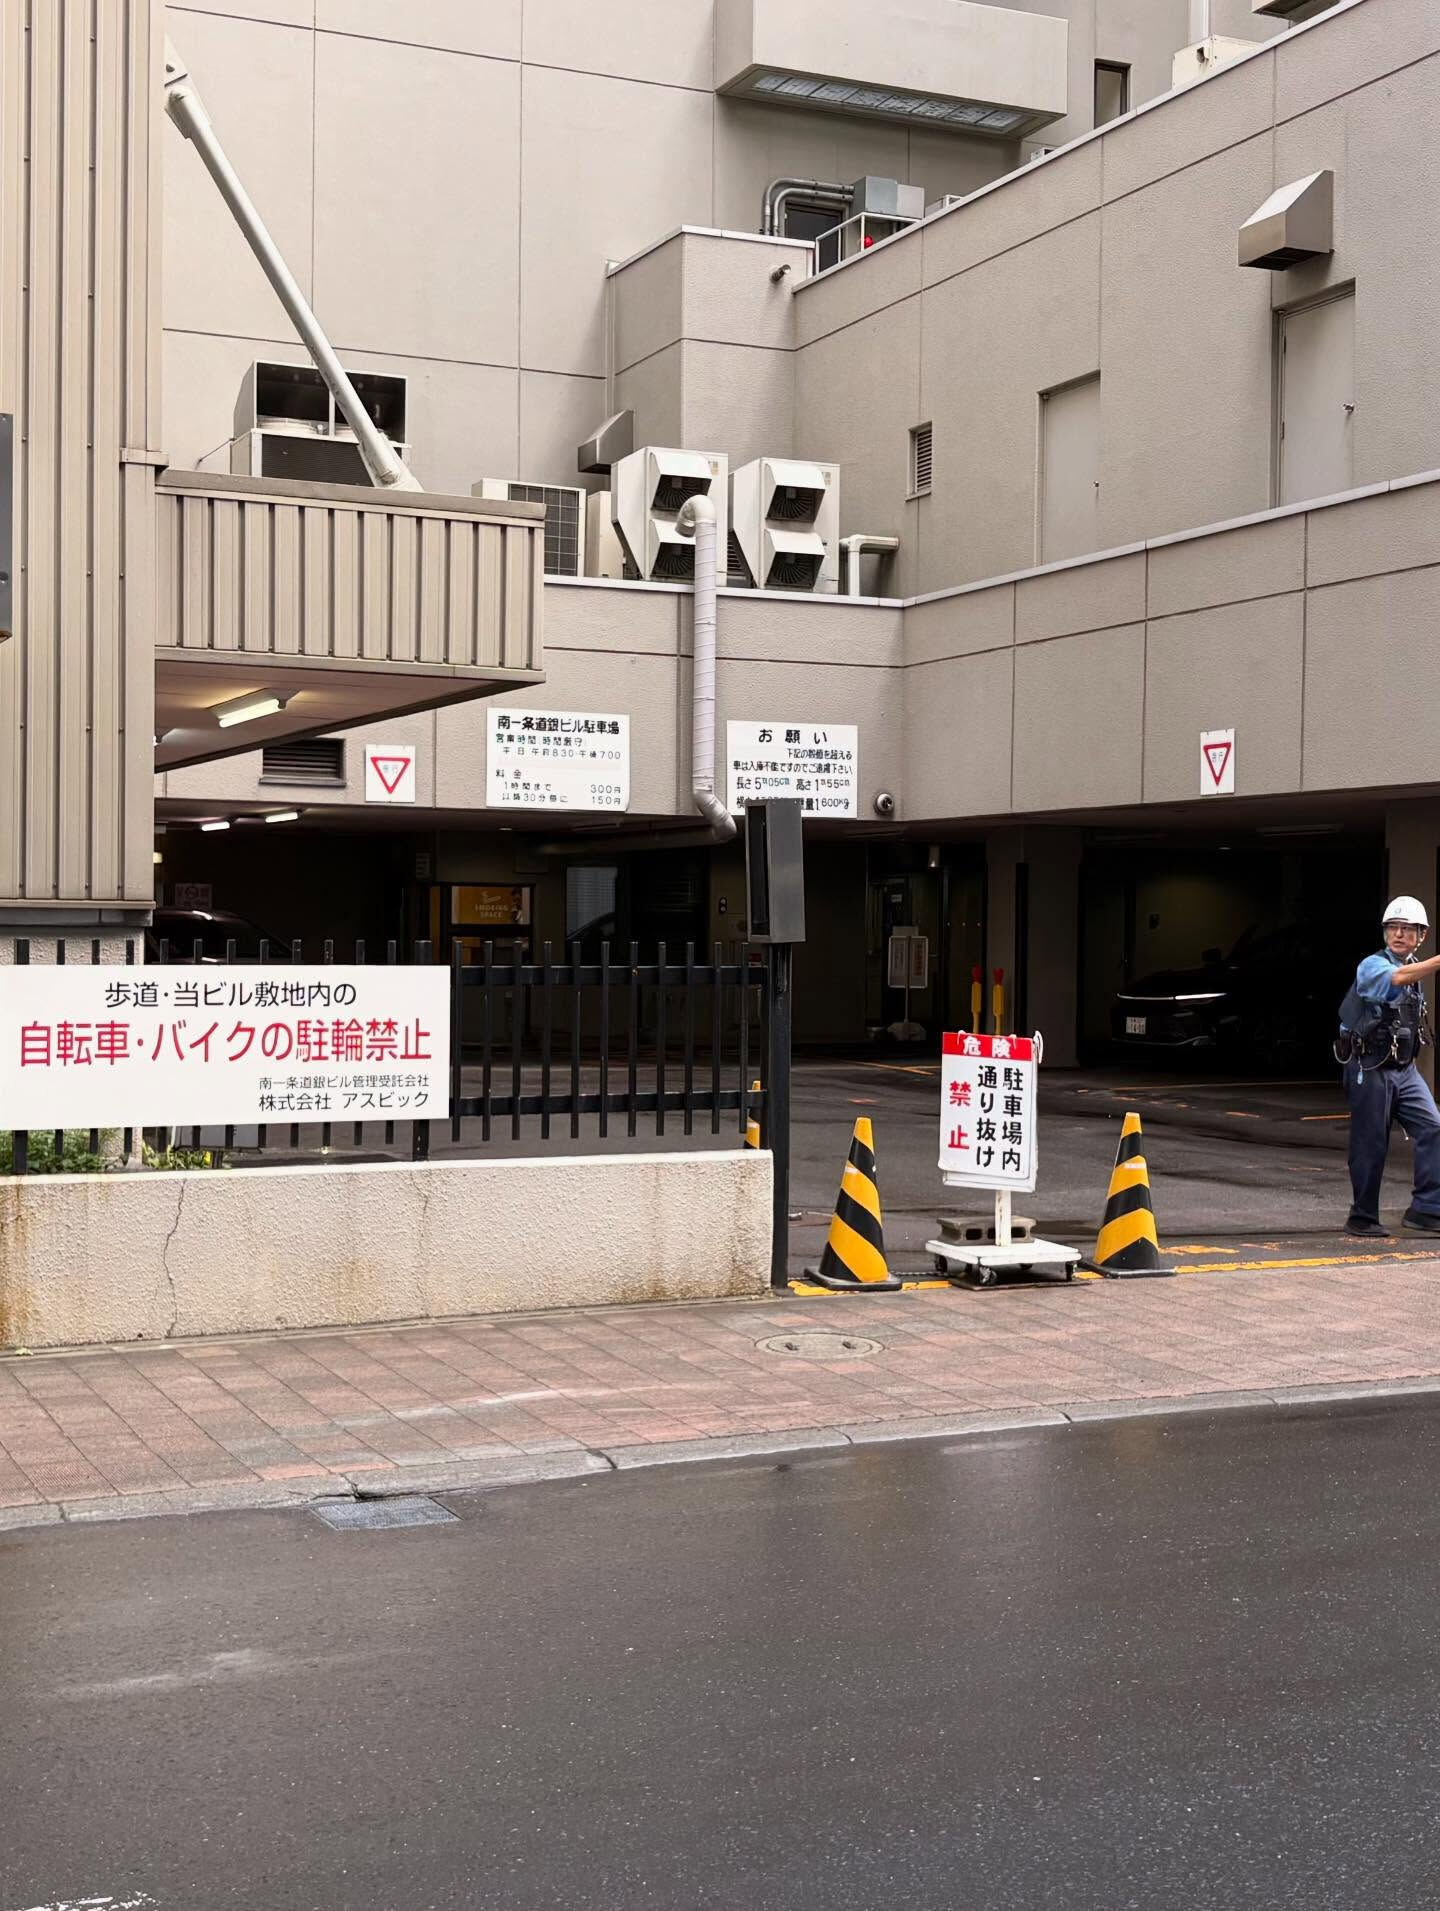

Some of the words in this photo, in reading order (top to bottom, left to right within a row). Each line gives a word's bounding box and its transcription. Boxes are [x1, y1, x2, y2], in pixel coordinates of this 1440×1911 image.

[497, 715, 620, 735] 南一条道銀ビル駐車場
[758, 729, 828, 745] お願い
[590, 784, 621, 794] 300円
[591, 795, 621, 805] 150円
[20, 1017, 432, 1067] 自転車・バイクの駐輪禁止
[963, 1035, 1013, 1058] 危険
[259, 1073, 431, 1091] 南一条道銀ビル管理受託会社
[258, 1092, 332, 1112] 株式会社
[948, 1080, 972, 1150] 禁止
[976, 1064, 998, 1167] 通り抜け
[1001, 1067, 1024, 1172] 駐車場内
